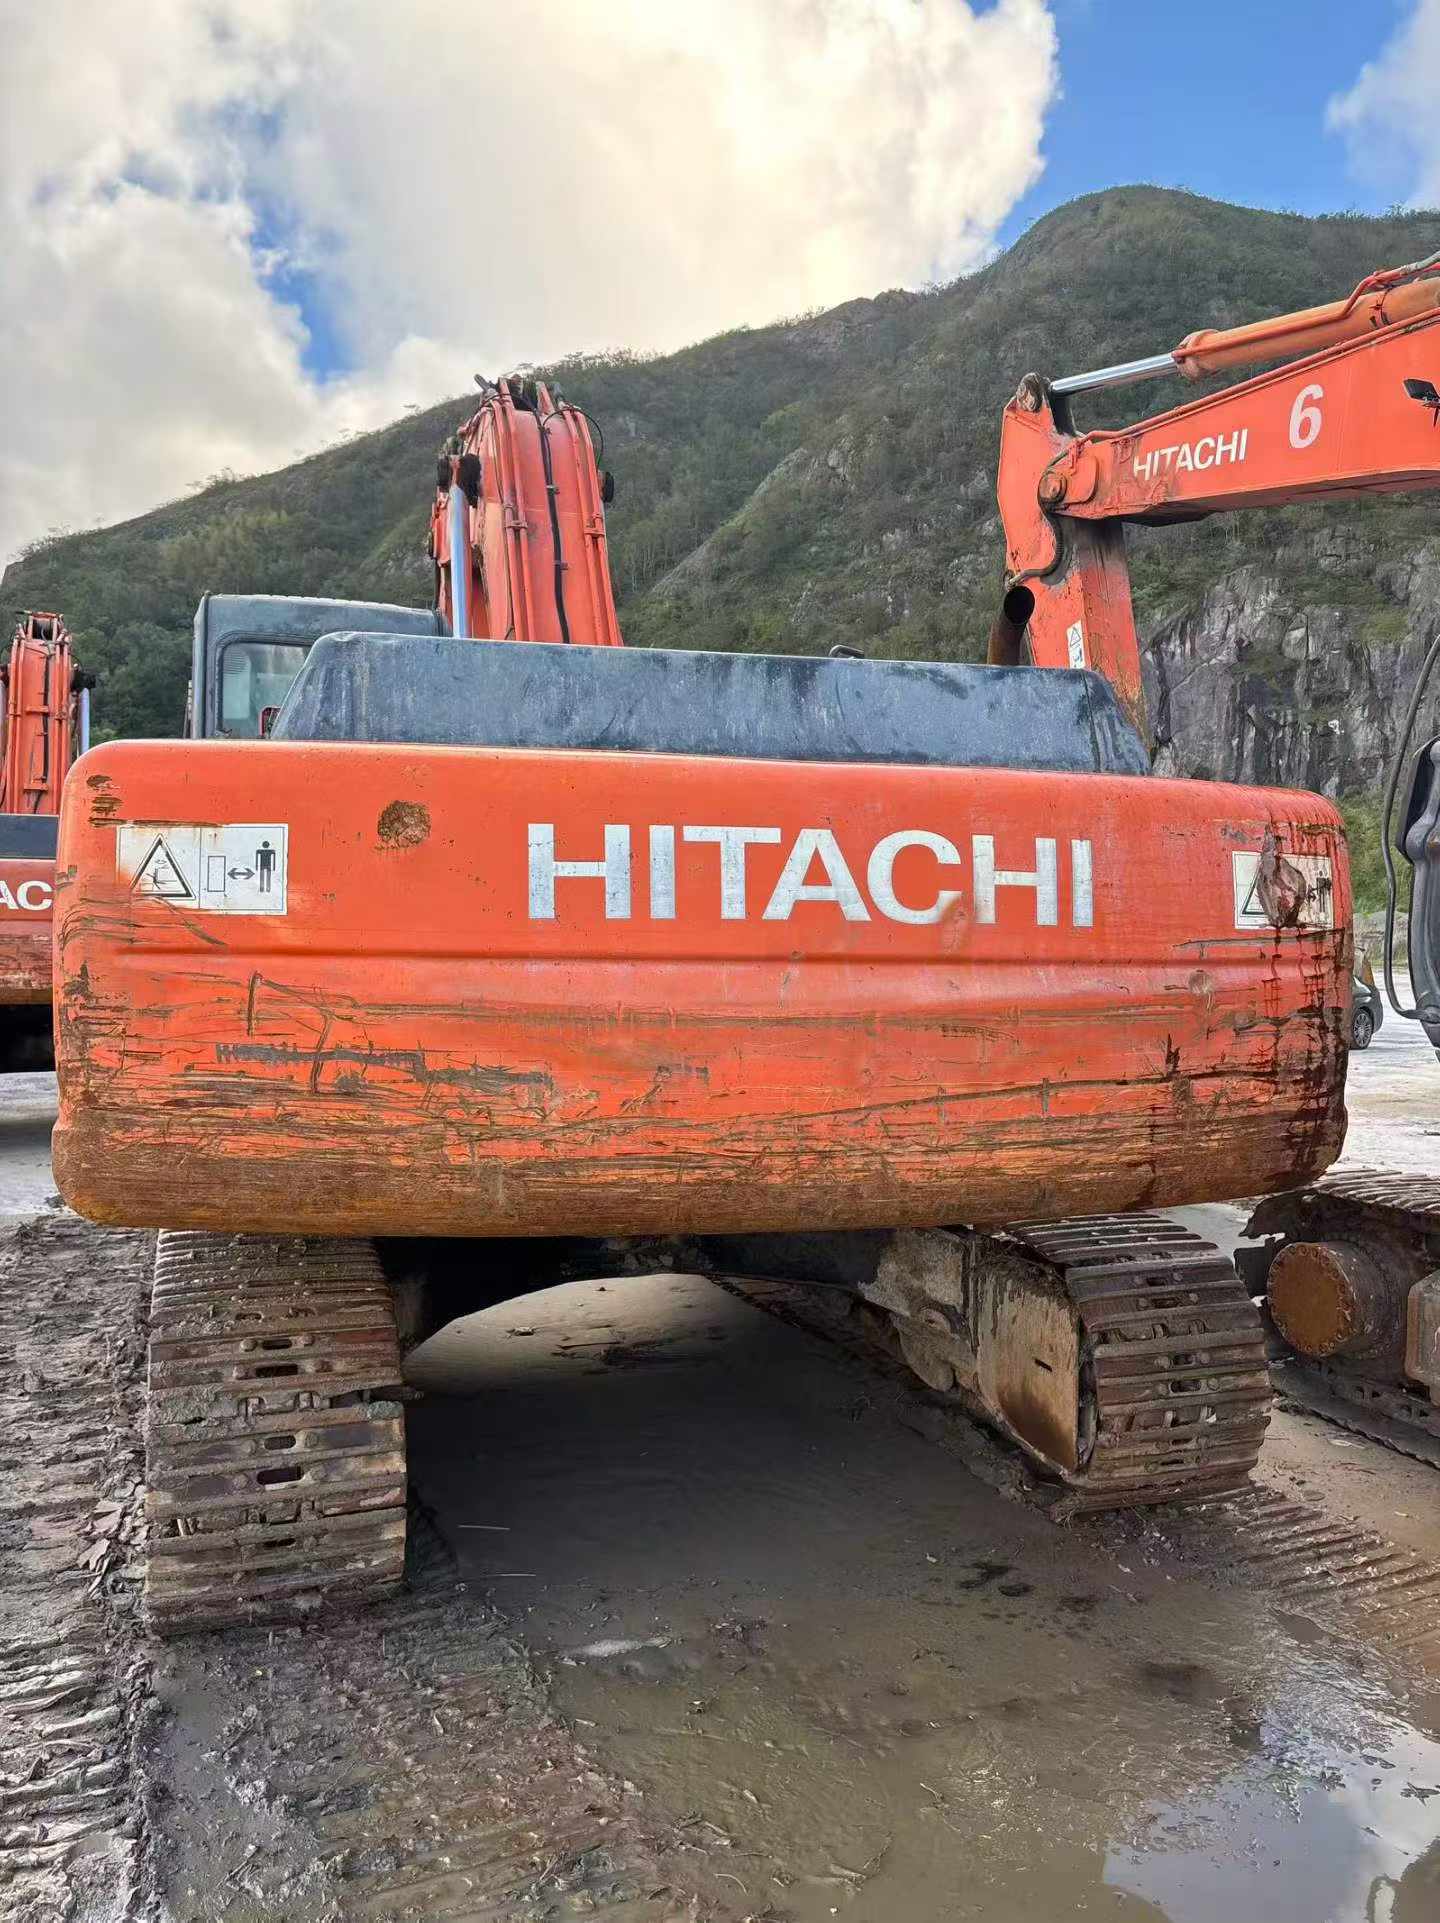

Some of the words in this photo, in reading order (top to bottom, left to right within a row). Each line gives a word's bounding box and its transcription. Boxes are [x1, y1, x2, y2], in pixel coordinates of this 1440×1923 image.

[1288, 383, 1324, 449] 6
[1133, 428, 1248, 481] HITACHI
[527, 823, 1094, 927] HITACHI
